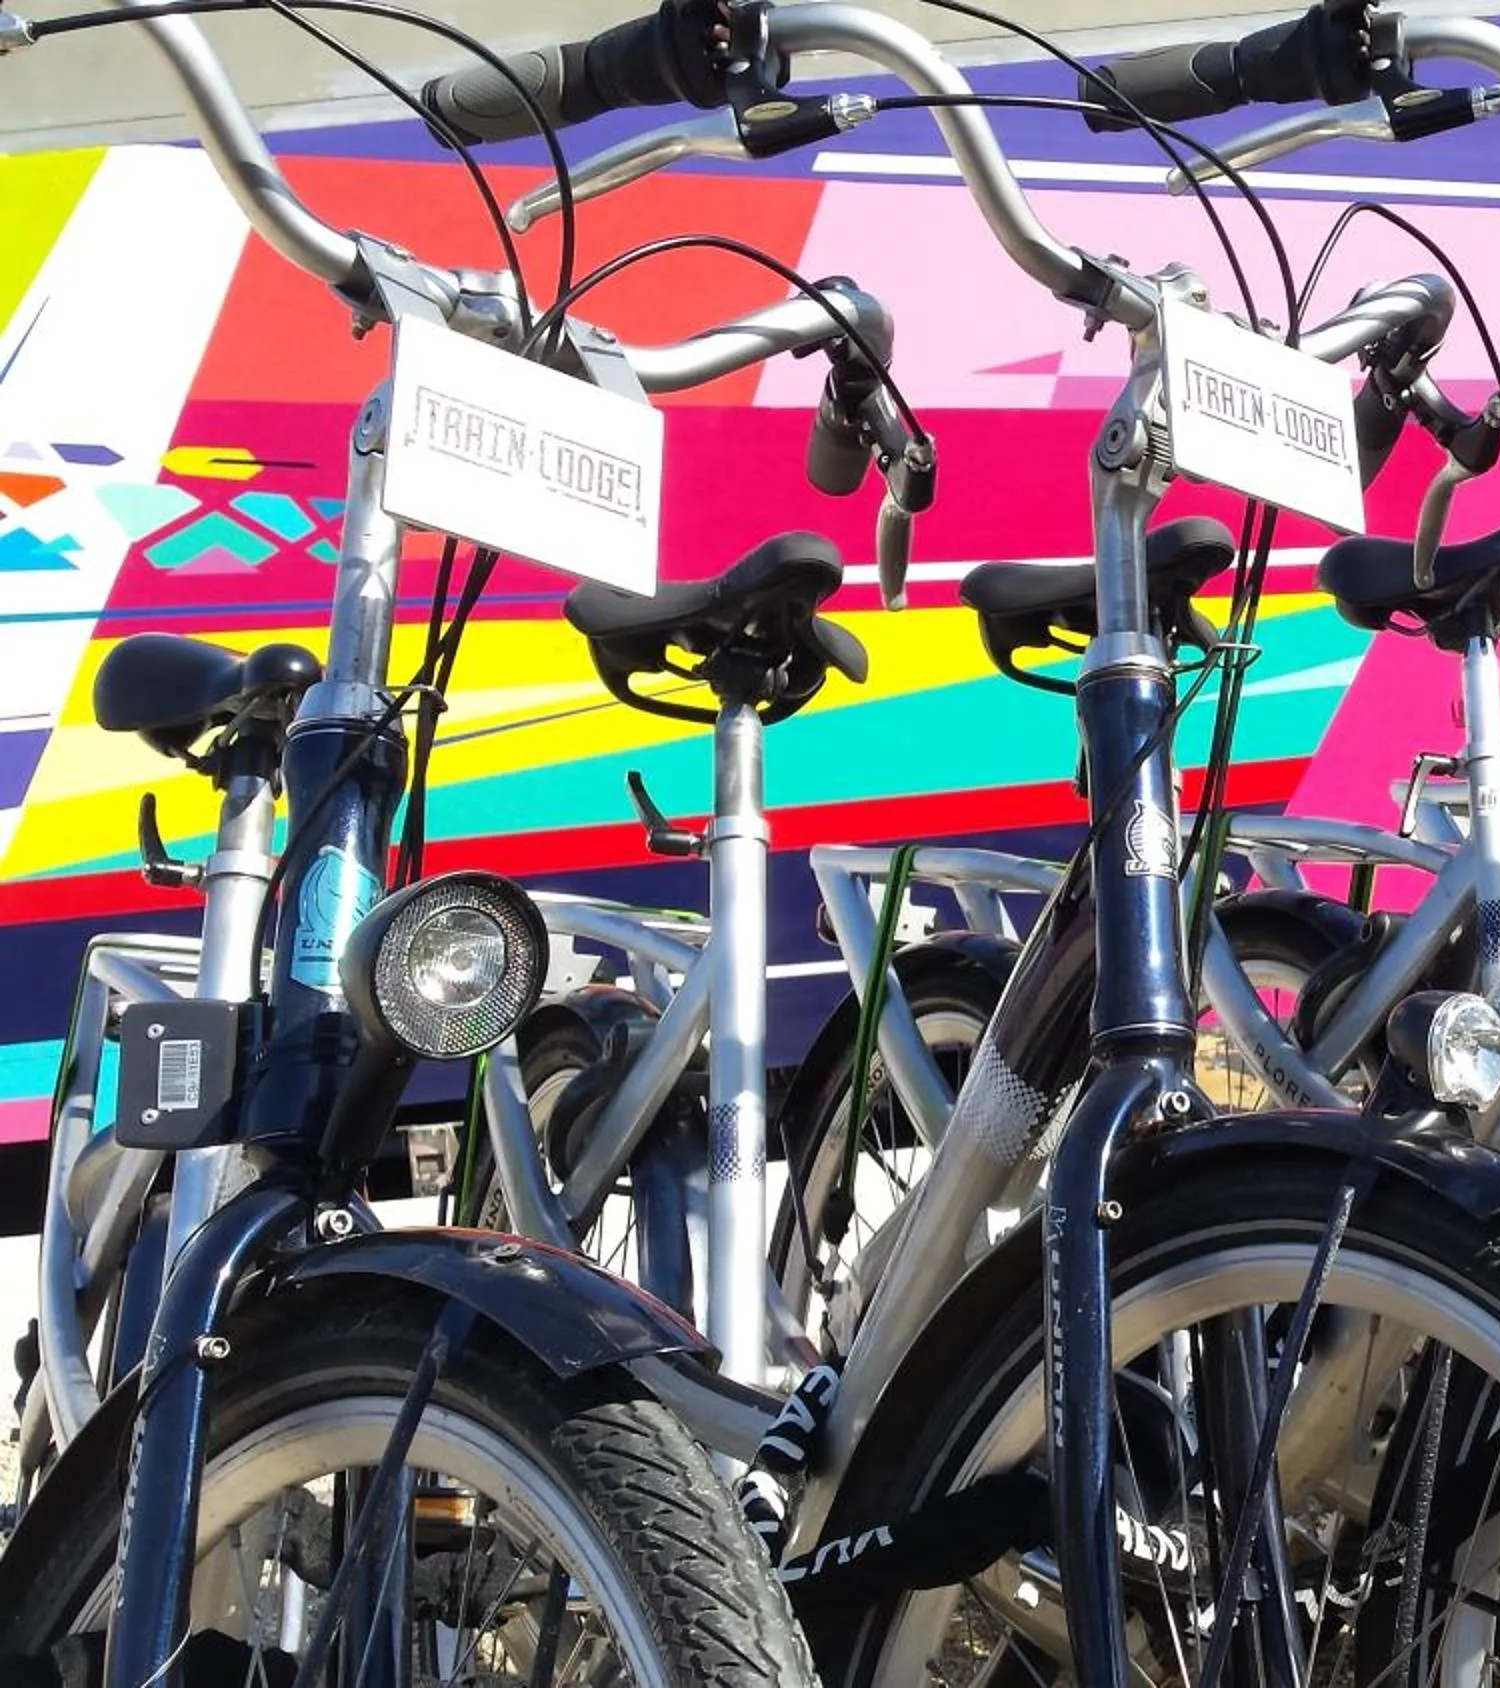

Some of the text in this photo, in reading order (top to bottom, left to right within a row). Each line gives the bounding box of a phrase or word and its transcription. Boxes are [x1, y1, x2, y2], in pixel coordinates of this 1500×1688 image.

[427, 398, 632, 507] TRAIN LODGE
[1192, 369, 1340, 457] TRAIN LODGE
